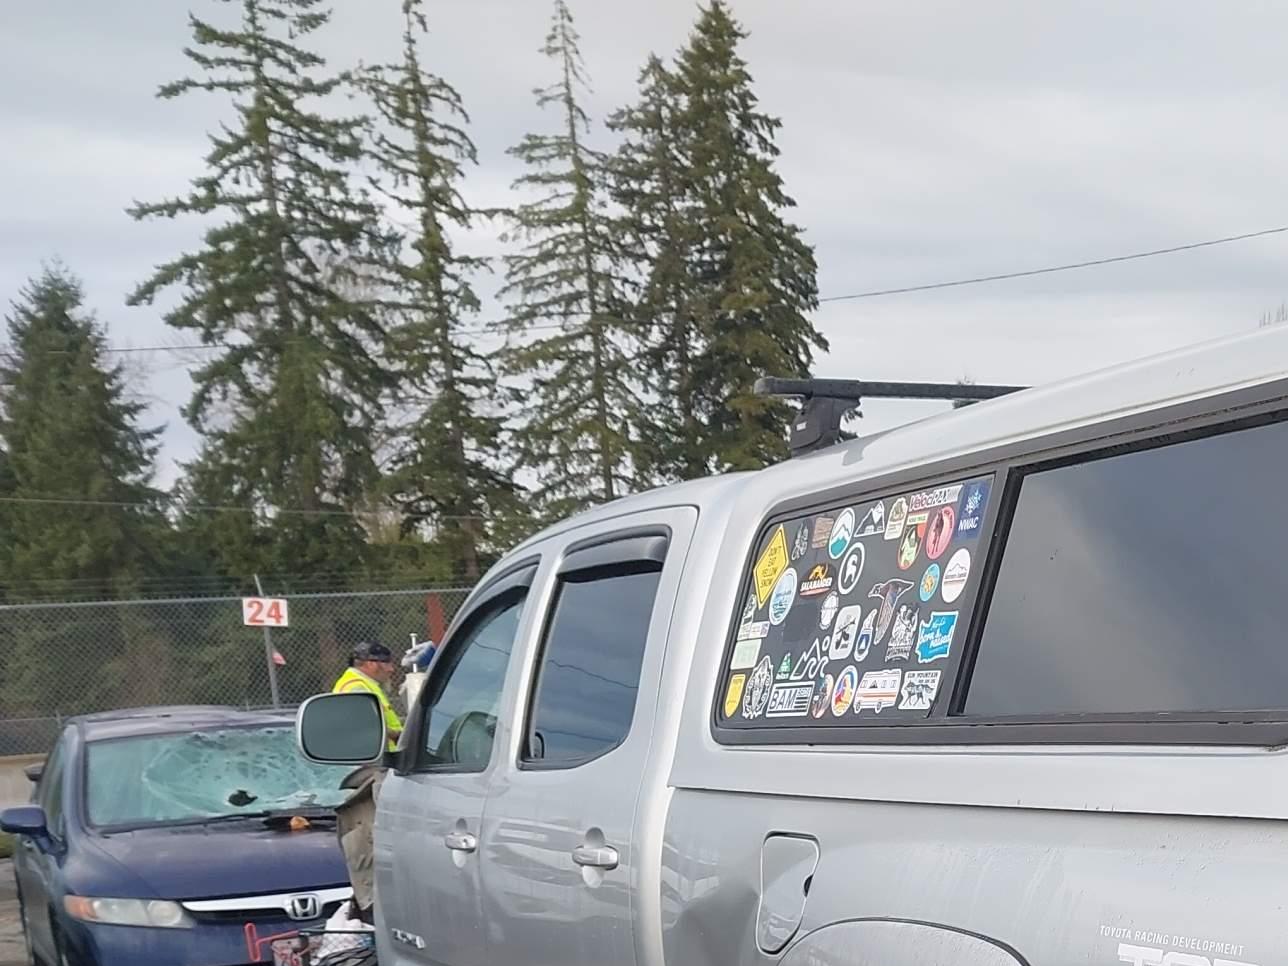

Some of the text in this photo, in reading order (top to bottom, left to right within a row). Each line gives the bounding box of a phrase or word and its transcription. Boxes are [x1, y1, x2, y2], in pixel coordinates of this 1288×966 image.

[958, 516, 979, 531] NWAC
[247, 600, 284, 624] 24
[769, 689, 798, 710] BAM
[1099, 925, 1245, 956] TOYOTA RACING DEVELOPMENT
